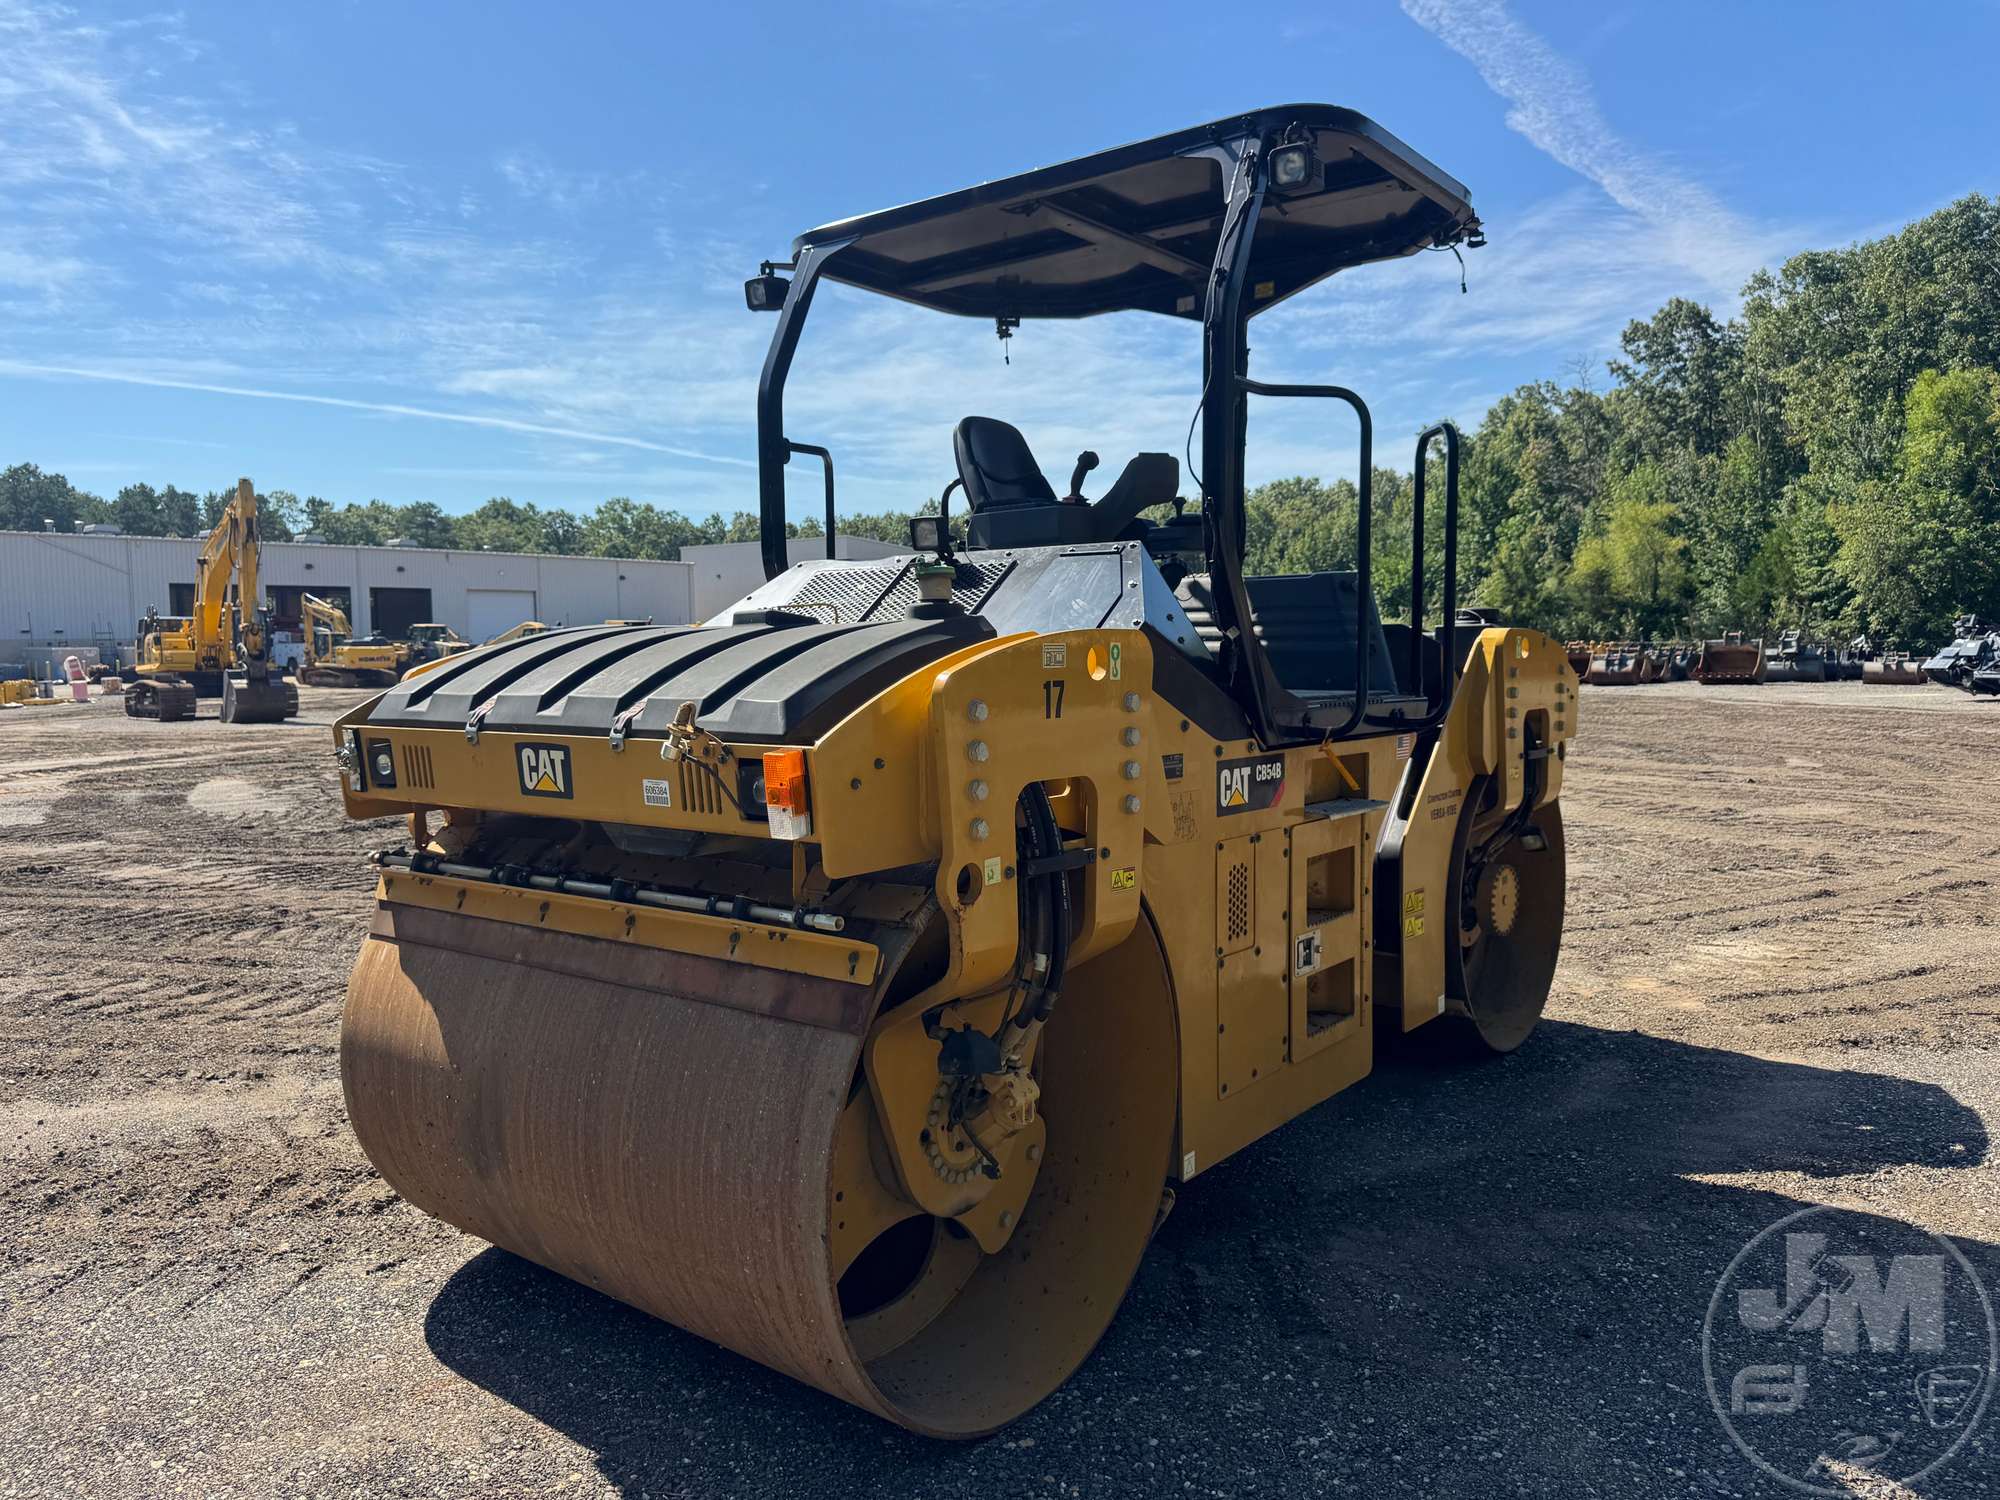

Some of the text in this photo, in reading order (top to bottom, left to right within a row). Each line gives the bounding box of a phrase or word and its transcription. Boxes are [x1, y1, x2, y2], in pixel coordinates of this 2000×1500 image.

[1043, 680, 1065, 719] 17
[521, 747, 565, 792] CAT
[1220, 762, 1282, 807] CAT CB54B
